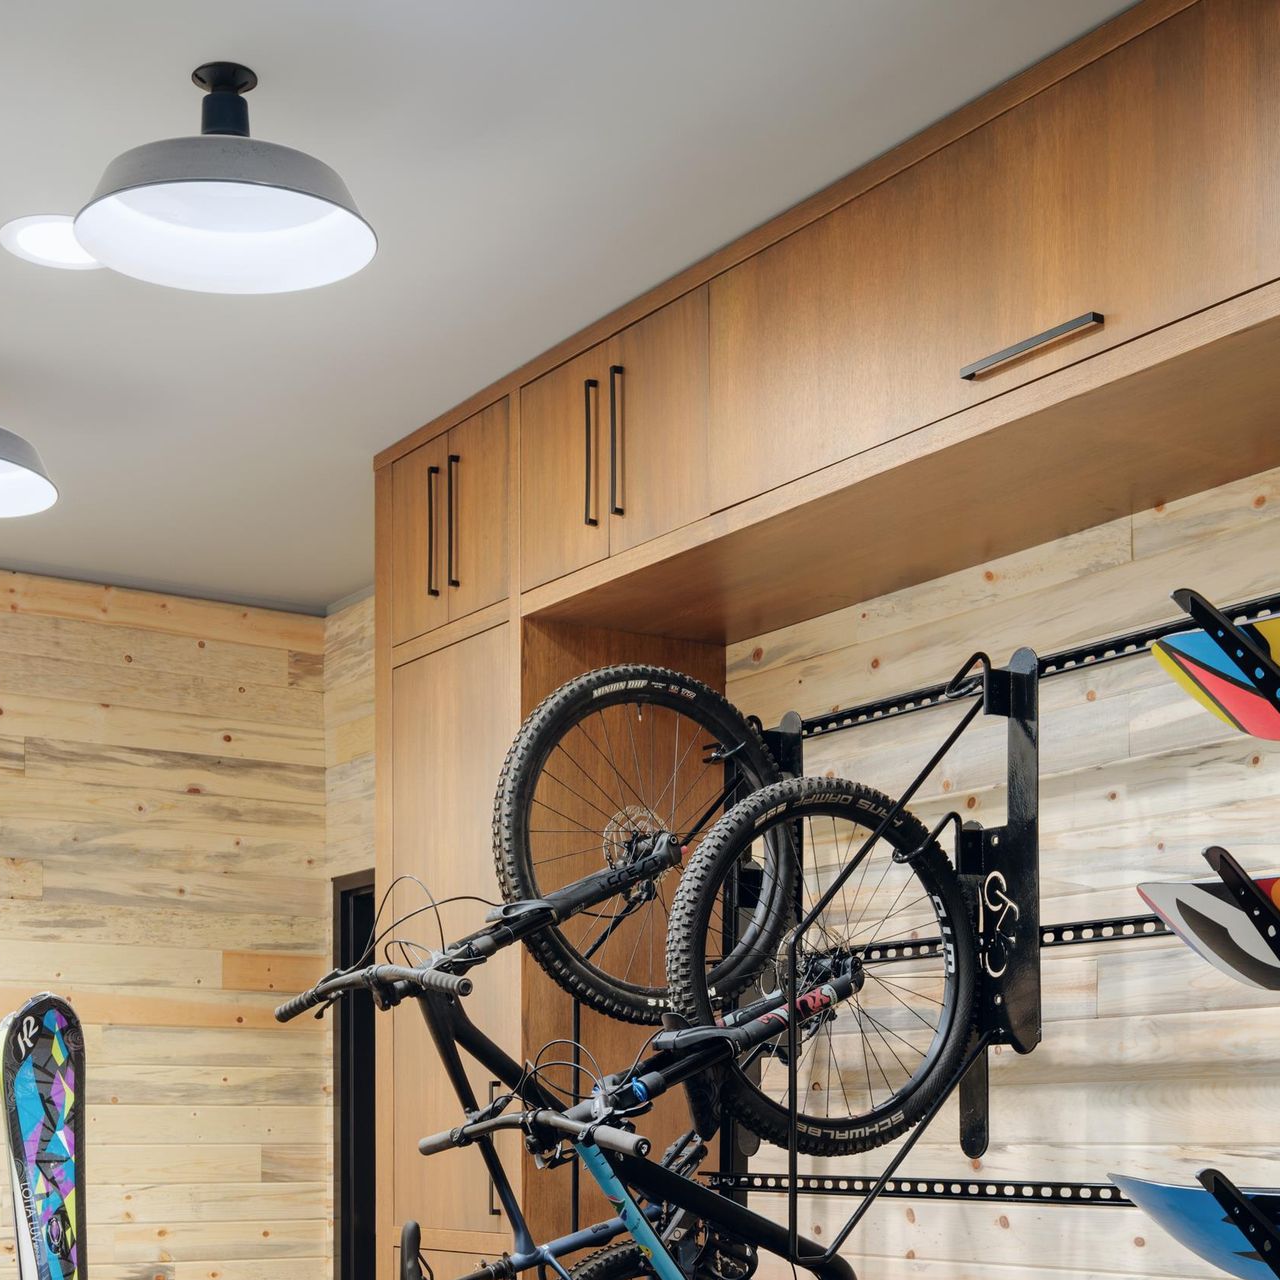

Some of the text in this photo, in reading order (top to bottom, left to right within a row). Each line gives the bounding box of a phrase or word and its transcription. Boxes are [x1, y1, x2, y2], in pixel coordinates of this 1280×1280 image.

[17, 1015, 39, 1060] K2
[795, 1110, 904, 1139] SCHWALBE
[20, 1182, 36, 1218] LOTTA
